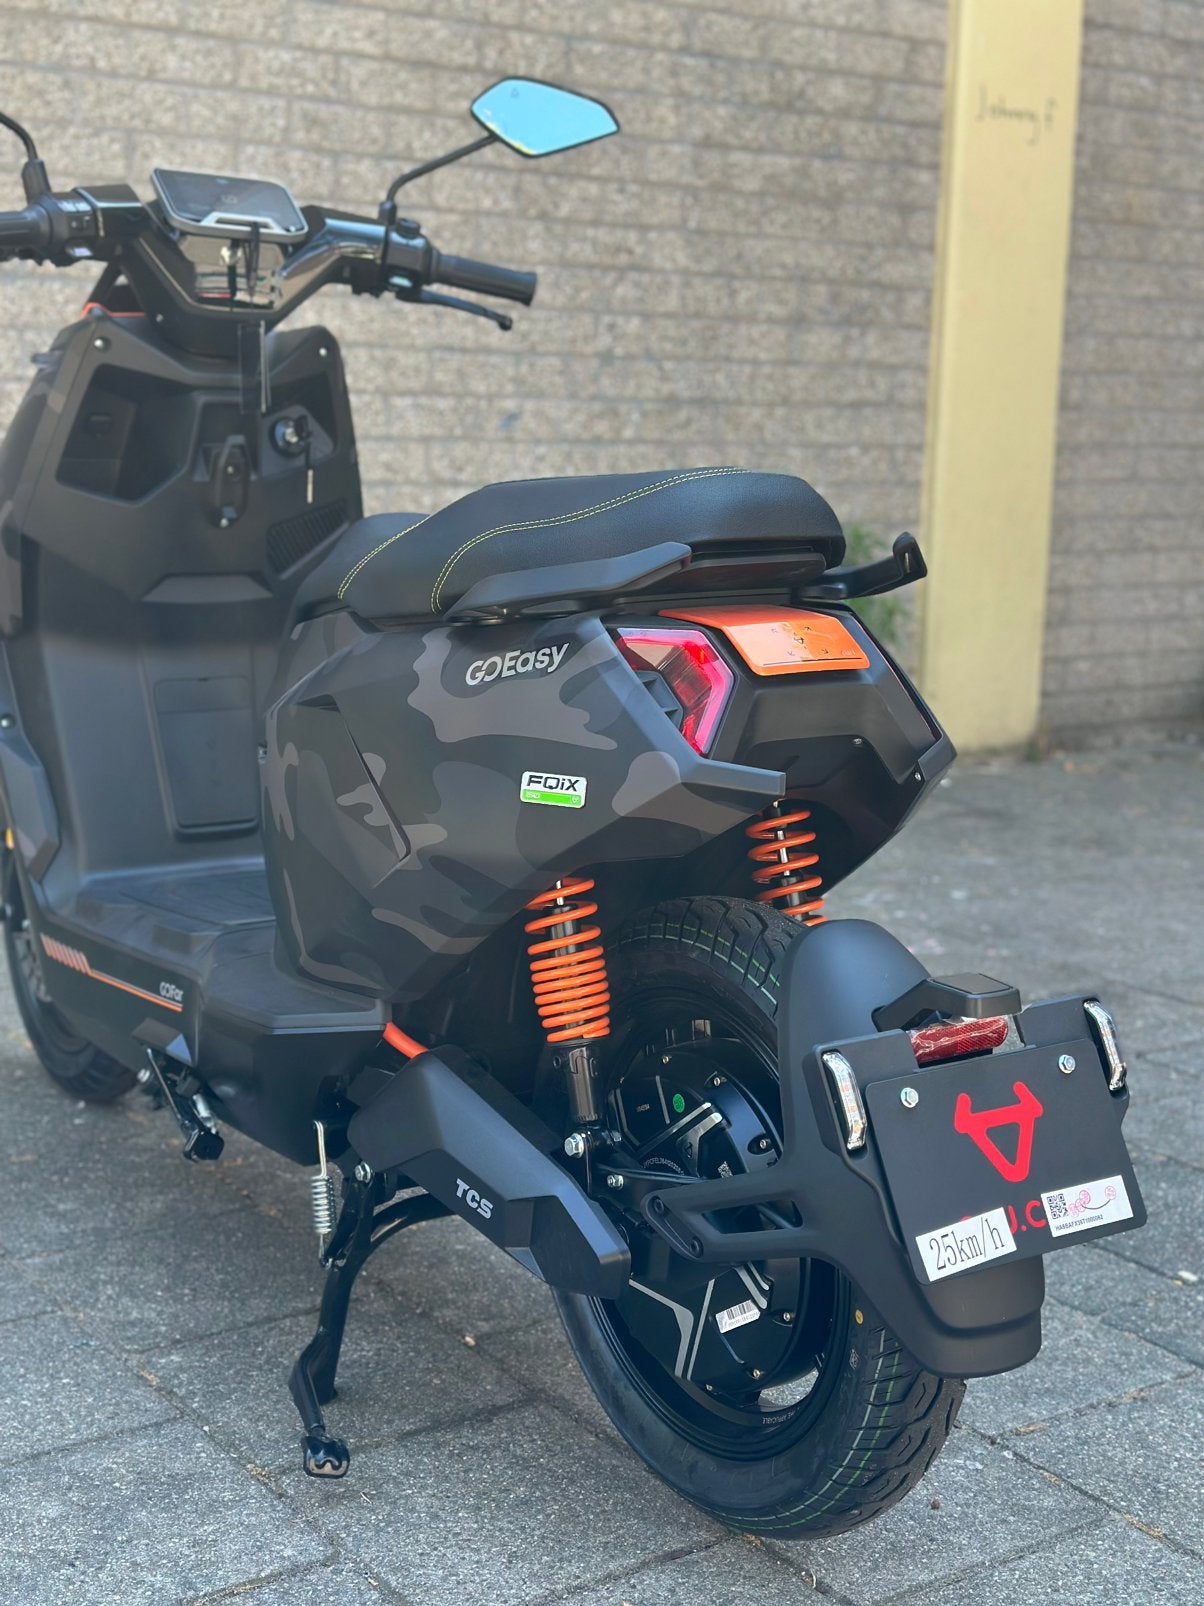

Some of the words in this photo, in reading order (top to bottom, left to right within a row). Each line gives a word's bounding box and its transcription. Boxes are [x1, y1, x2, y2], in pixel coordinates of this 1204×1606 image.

[465, 643, 570, 686] GOEasy
[456, 1178, 494, 1219] TCS
[929, 1217, 1005, 1271] 25km/h
